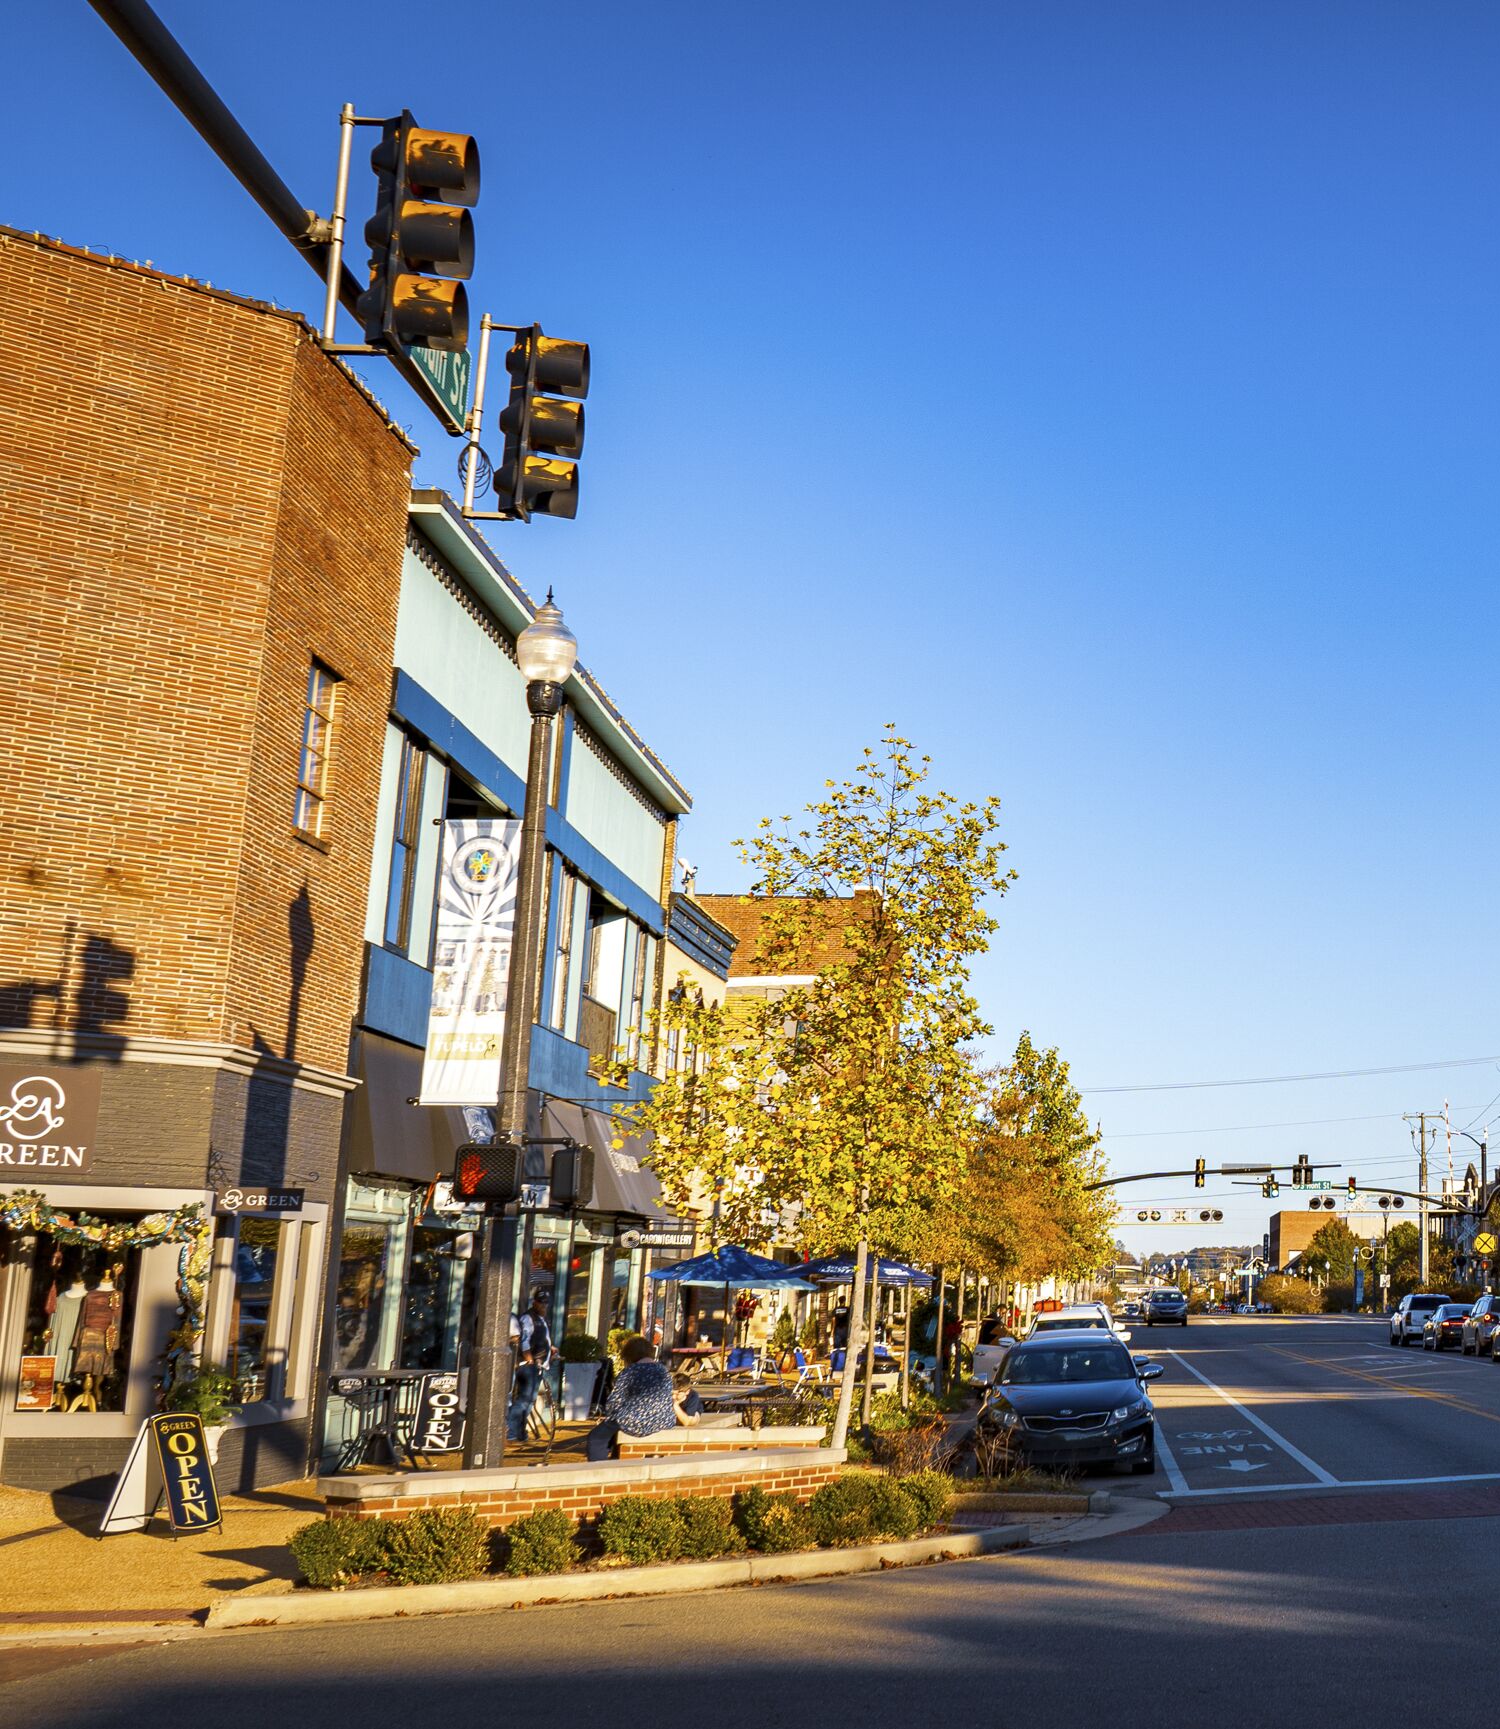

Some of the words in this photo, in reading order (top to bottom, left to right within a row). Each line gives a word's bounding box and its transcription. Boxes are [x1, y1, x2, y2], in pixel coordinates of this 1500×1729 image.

[450, 353, 466, 415] St
[0, 1143, 87, 1167] REEN
[246, 1194, 300, 1207] GREEN
[665, 1234, 694, 1246] GALLERY
[169, 1421, 196, 1431] GREEN
[423, 1393, 459, 1450] OPEN
[1180, 1443, 1273, 1455] LANE
[168, 1432, 208, 1525] OPEN
